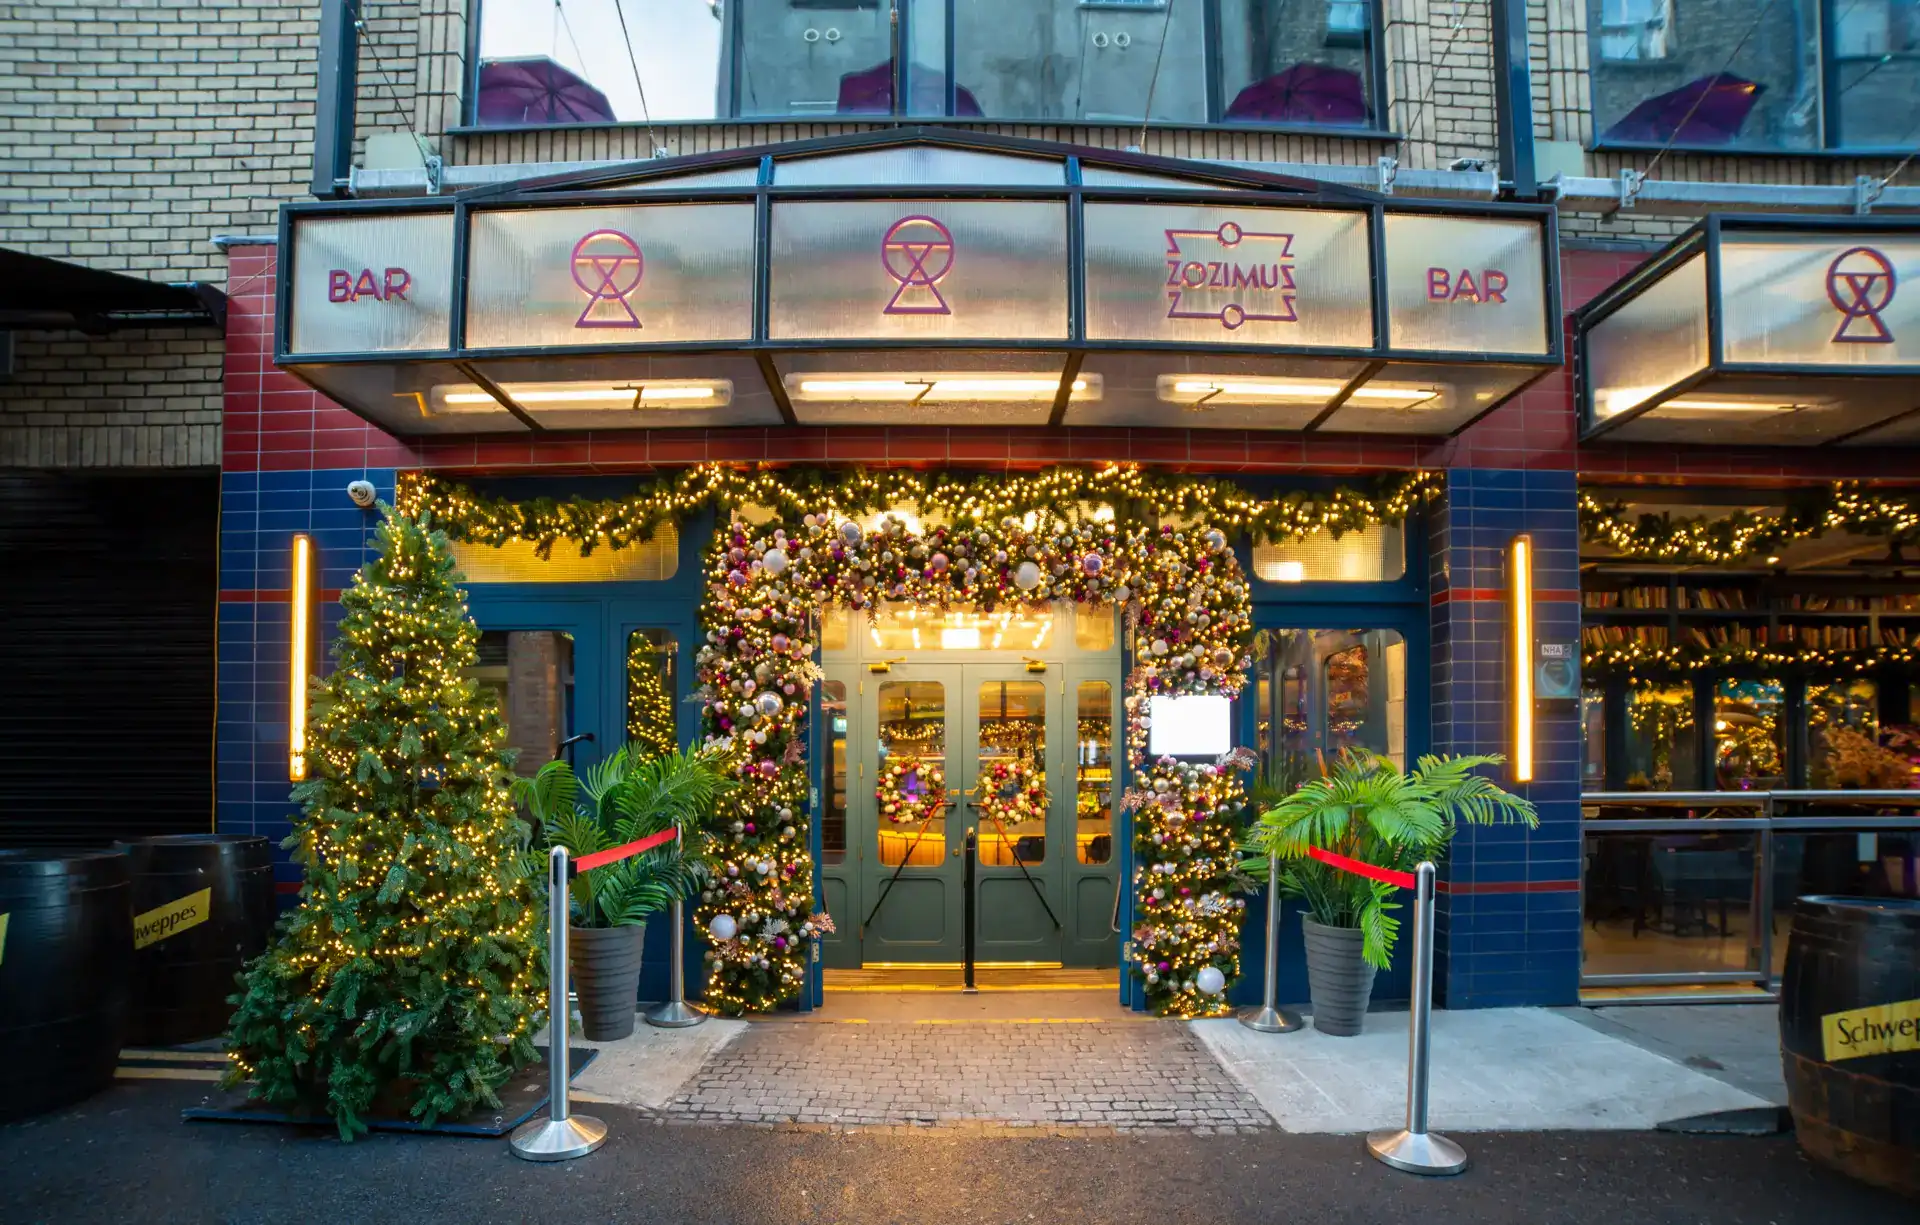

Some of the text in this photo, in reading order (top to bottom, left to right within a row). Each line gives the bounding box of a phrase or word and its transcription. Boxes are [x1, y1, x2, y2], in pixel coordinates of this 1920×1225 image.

[328, 267, 412, 303] BAR
[1166, 260, 1297, 290] ZOZIMUS
[1427, 267, 1508, 303] BAR
